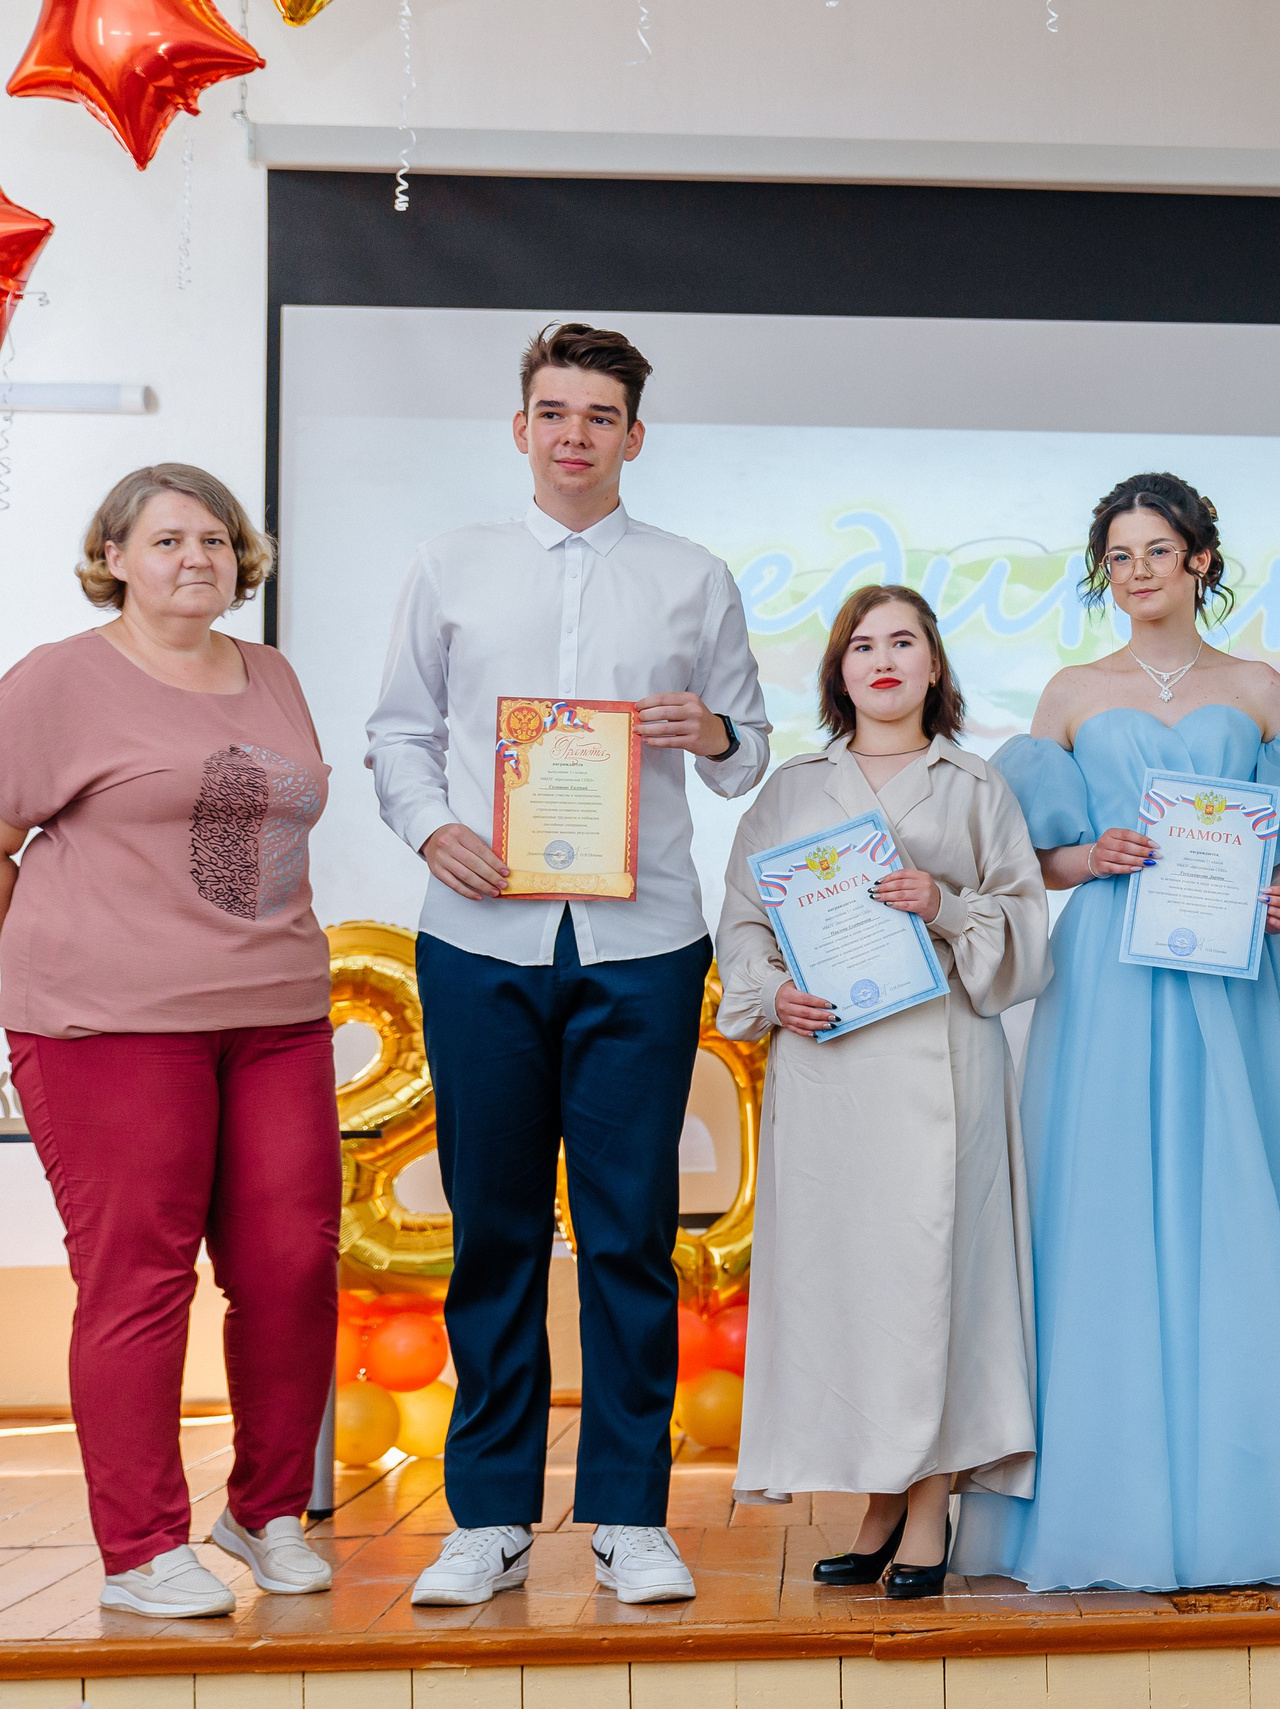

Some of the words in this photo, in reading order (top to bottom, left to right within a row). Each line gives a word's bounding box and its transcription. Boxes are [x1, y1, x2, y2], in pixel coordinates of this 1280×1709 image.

[550, 735, 611, 765] Грамота
[1168, 826, 1242, 845] ГРАМОТА
[797, 873, 870, 907] ГРАМОТА
